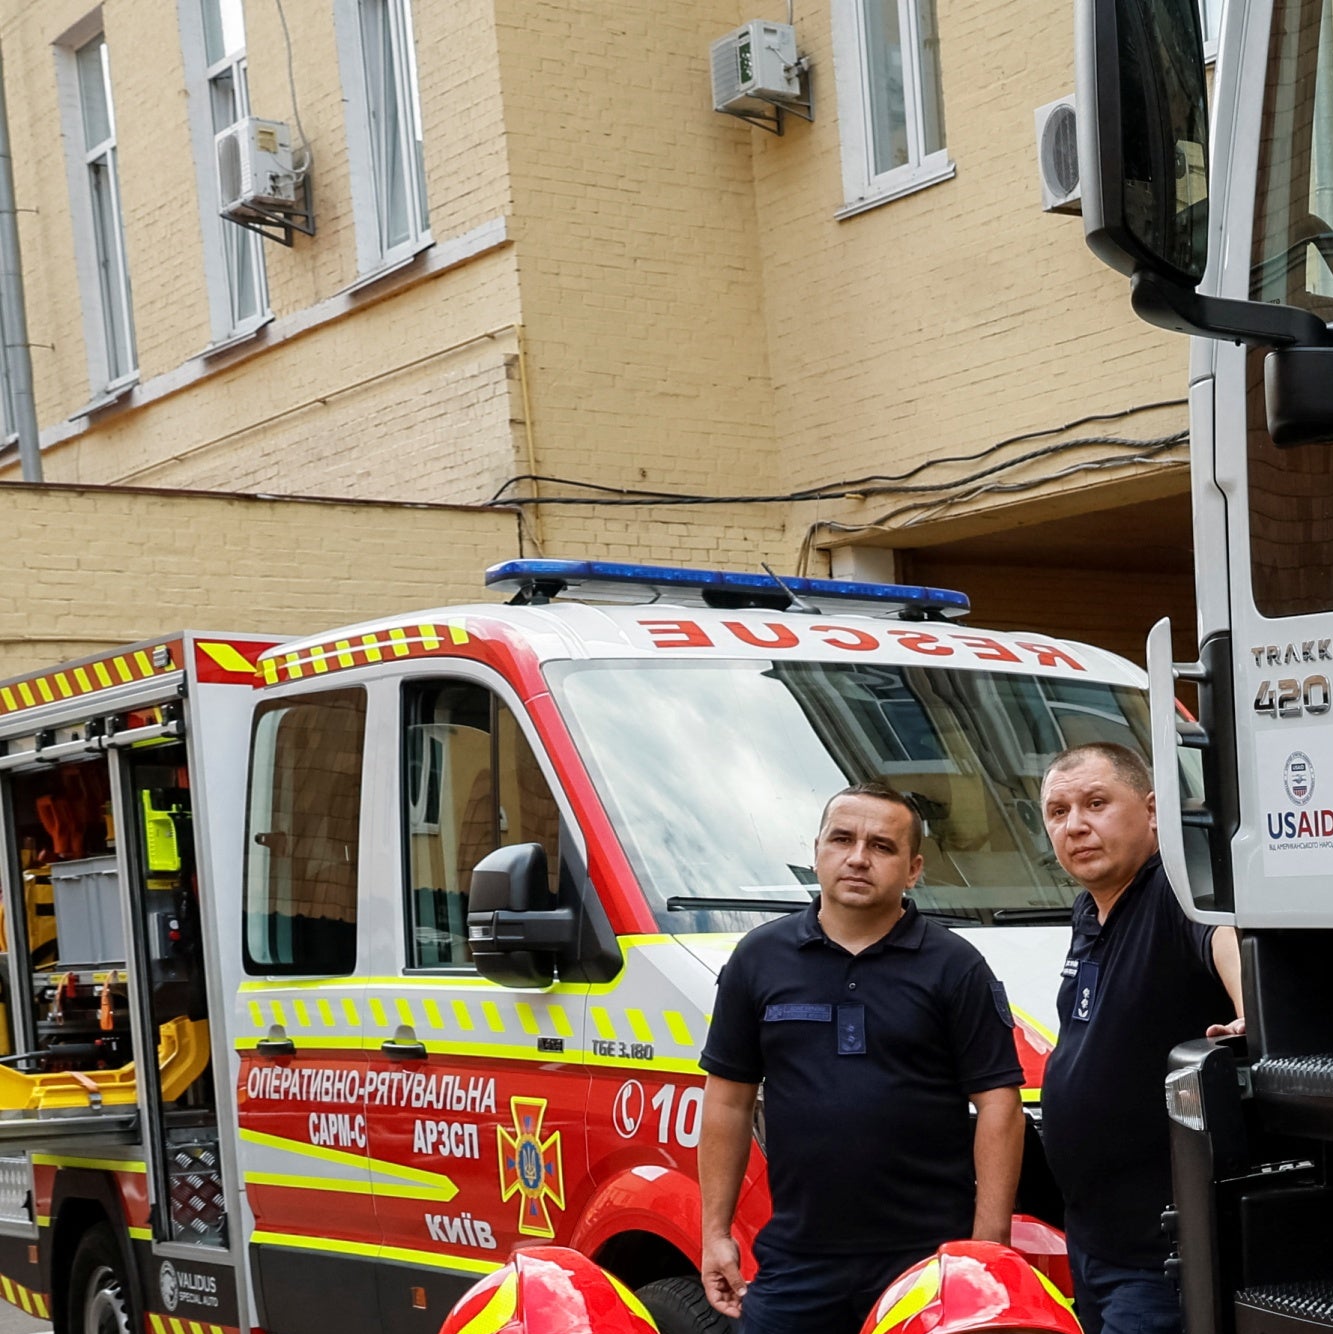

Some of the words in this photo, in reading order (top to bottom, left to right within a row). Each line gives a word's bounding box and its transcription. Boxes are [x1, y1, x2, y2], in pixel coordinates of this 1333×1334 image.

[1254, 675, 1331, 718] 420
[592, 1039, 617, 1057] TGE
[618, 1042, 654, 1060] 3.180
[247, 1066, 496, 1113] ОПЕРАТИВНО-РЯТУВАЛЬНА
[308, 1112, 366, 1148] САРМ-С
[413, 1119, 480, 1159] АРЗСП
[425, 1212, 497, 1249] КИЇВ
[177, 1271, 217, 1293] VALIDUS
